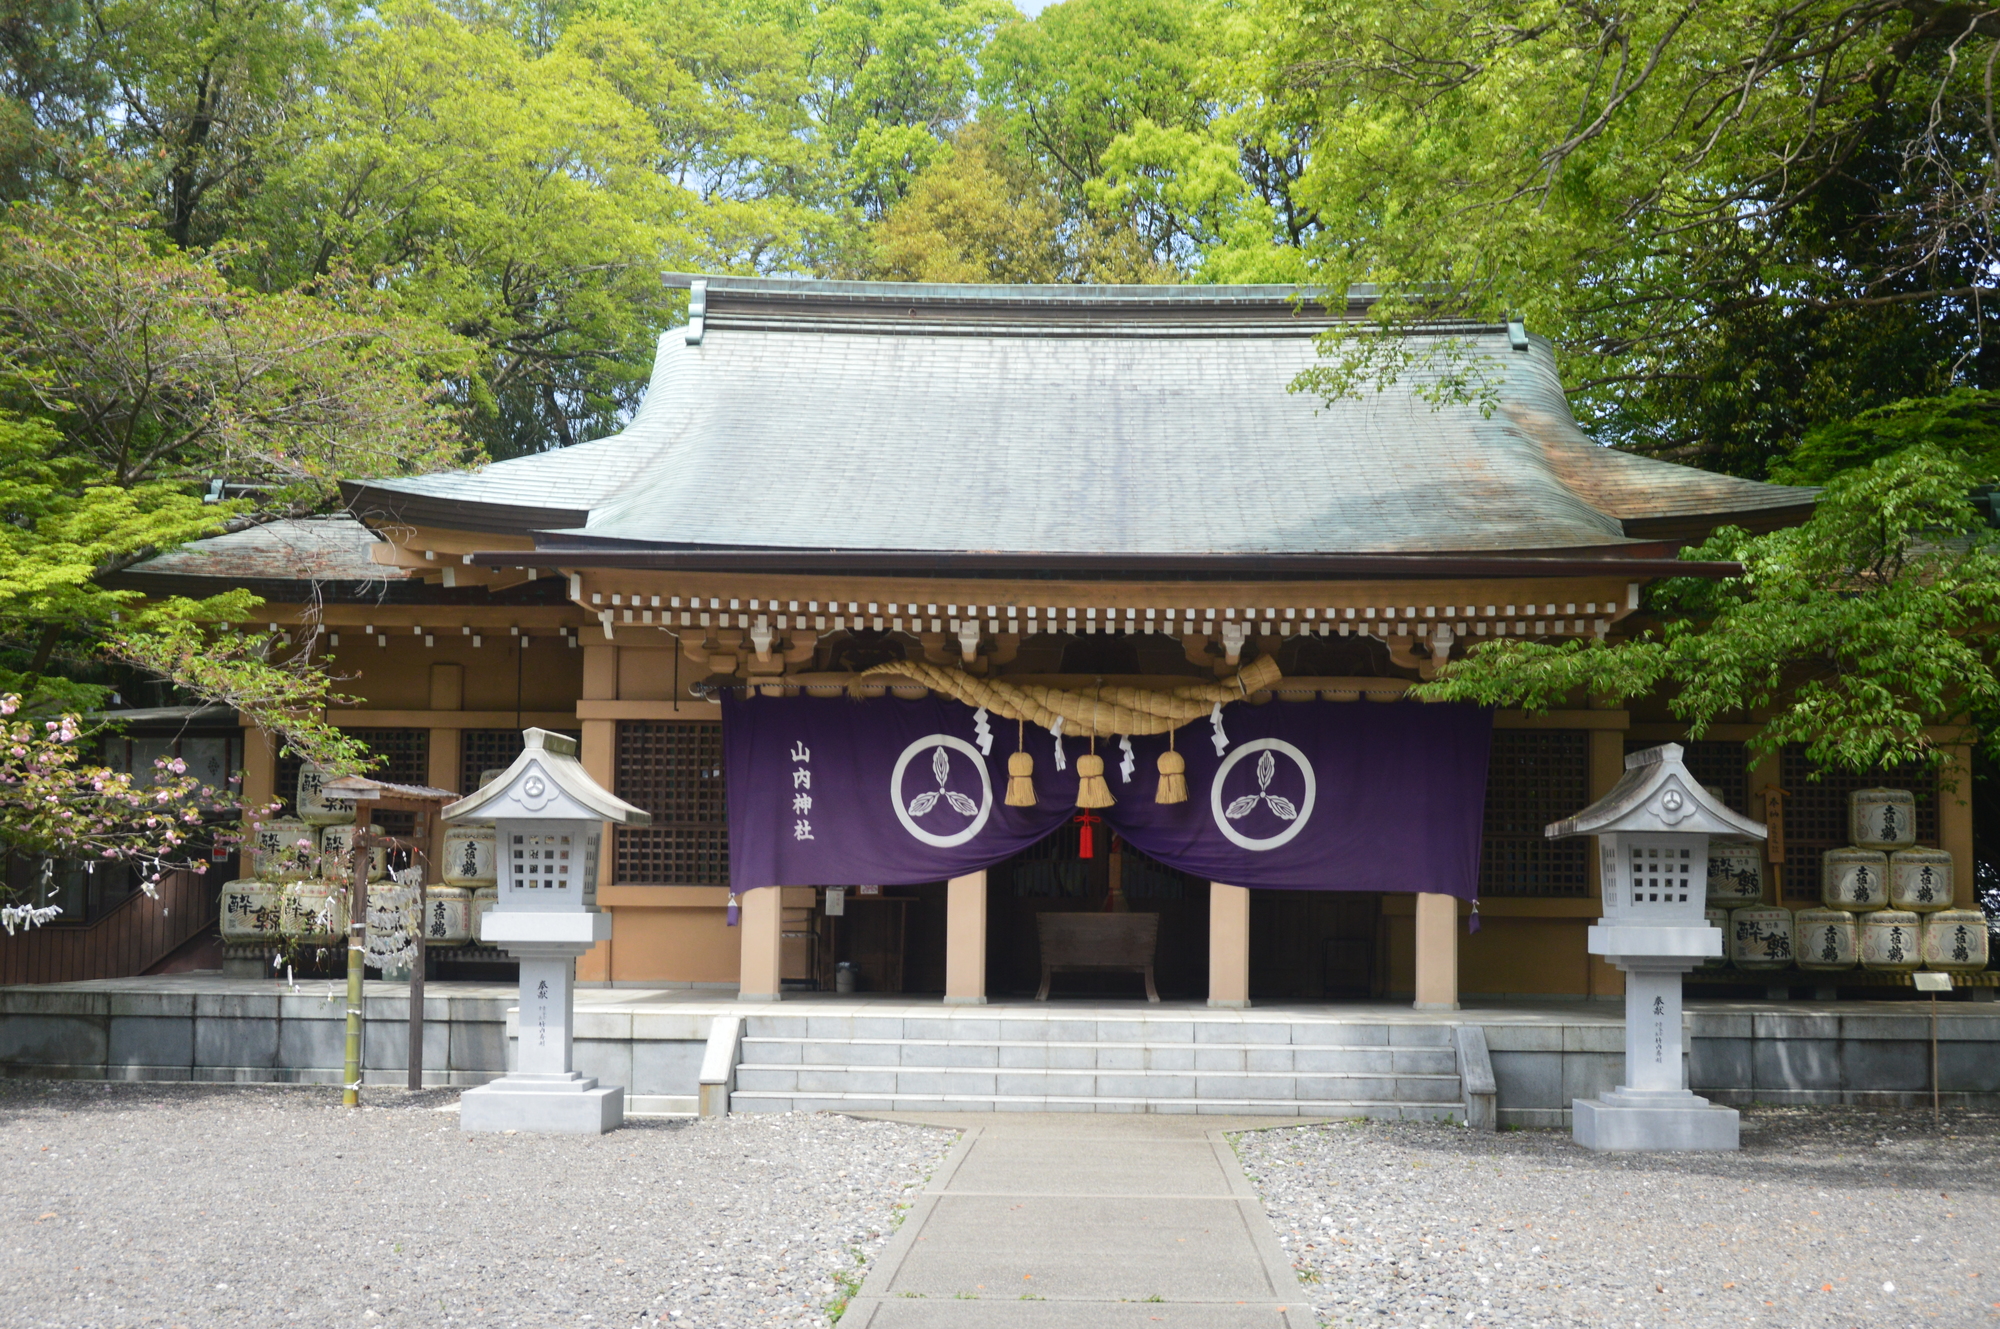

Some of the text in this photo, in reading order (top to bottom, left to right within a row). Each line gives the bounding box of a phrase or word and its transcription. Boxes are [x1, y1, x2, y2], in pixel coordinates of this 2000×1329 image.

[790, 740, 815, 841] 山内神社
[1880, 804, 1898, 841] 土佐鶴
[460, 840, 478, 877] 土佐鶴
[1706, 858, 1760, 896] 酔鯨
[1853, 865, 1870, 902] 土佐鶴
[1917, 865, 1934, 902] 土佐鶴
[227, 894, 281, 932] 酔鯨
[429, 900, 447, 937] 土佐鶴
[1736, 920, 1791, 959] 酔鯨
[1821, 924, 1839, 962] 土佐鶴
[1887, 925, 1904, 962] 土佐鶴
[1952, 924, 1969, 962] 土佐鶴
